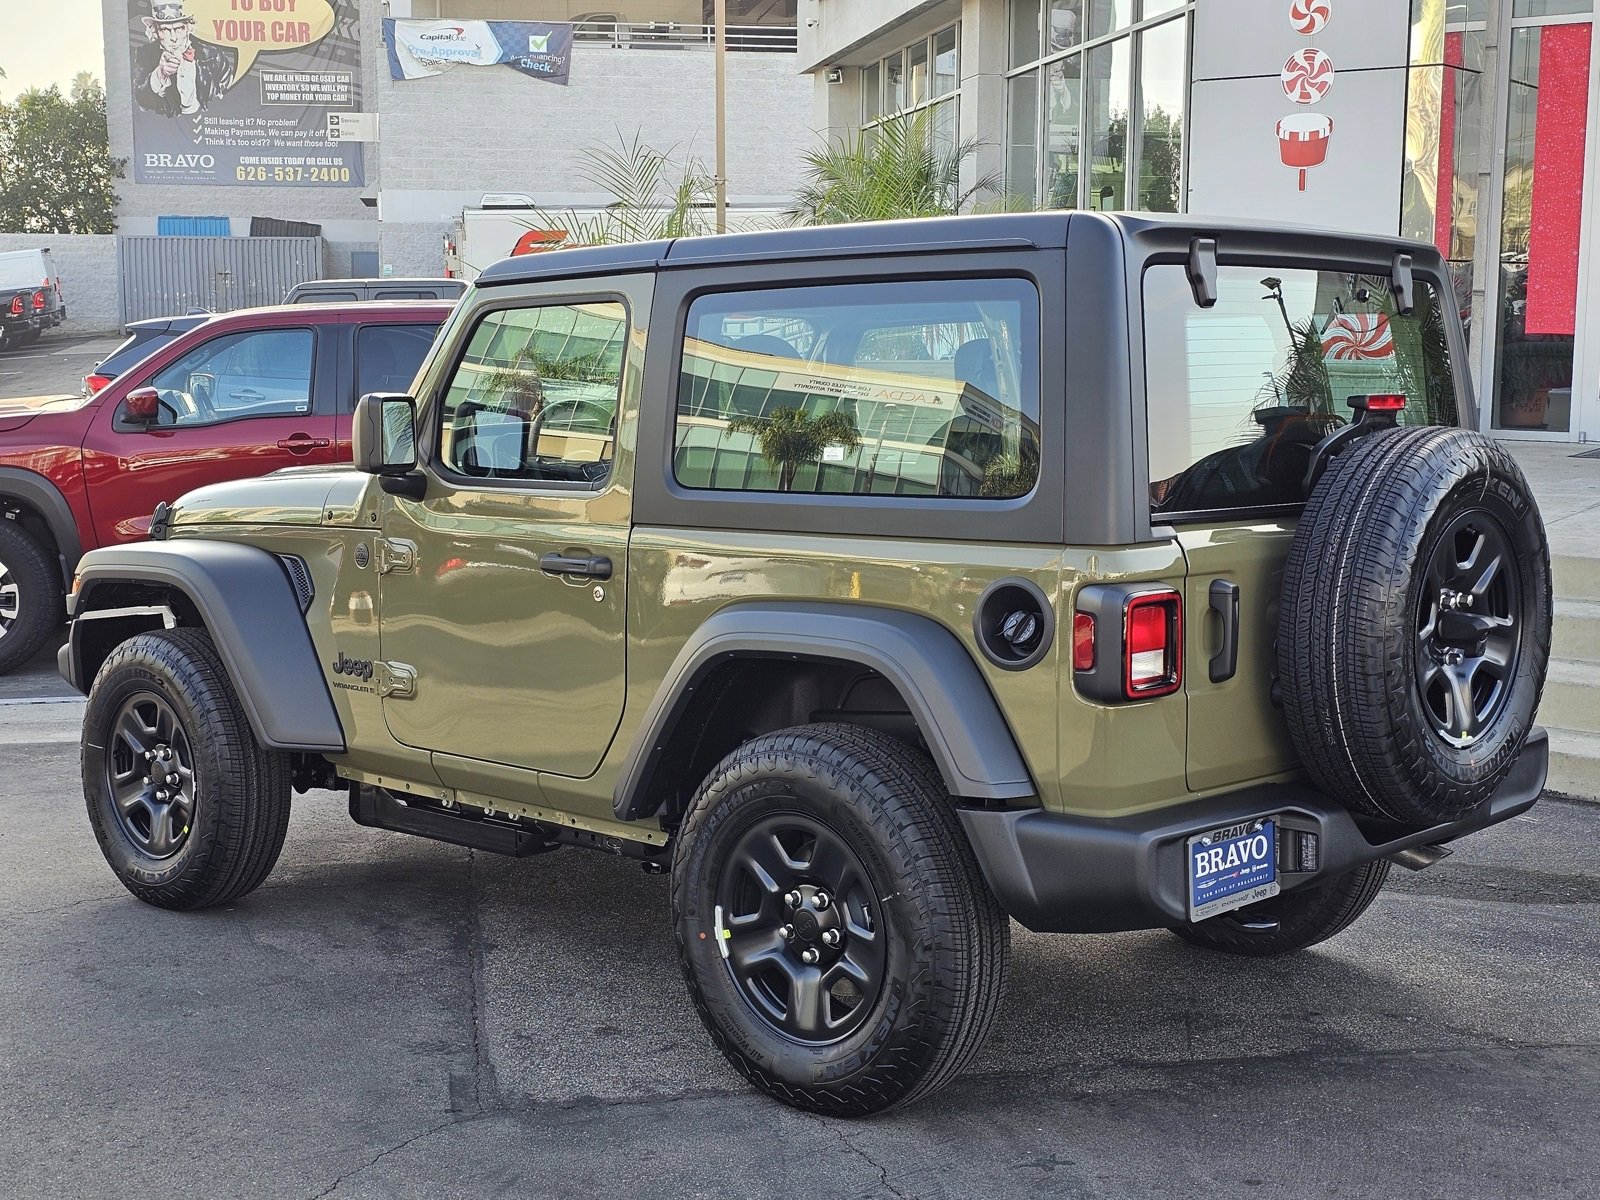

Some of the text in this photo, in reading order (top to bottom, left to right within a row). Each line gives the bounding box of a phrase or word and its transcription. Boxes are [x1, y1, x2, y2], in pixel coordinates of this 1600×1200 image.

[212, 19, 311, 43] YOUR CAR
[520, 58, 553, 73] Check.
[263, 73, 350, 83] WE ARE IN NEED OF USED CAR
[300, 84, 310, 92] SO
[310, 84, 320, 92] WE
[321, 84, 336, 92] WILL
[336, 85, 348, 93] PAY
[266, 92, 279, 100] TOP
[280, 93, 301, 101] MONEY
[302, 93, 314, 101] FOR
[314, 93, 332, 101] YOUR
[204, 116, 298, 127] Still leasing it? No problem!
[204, 127, 229, 137] Making
[294, 130, 308, 138] pay
[315, 129, 325, 137] off
[204, 138, 224, 146] Think
[225, 138, 236, 146] it's
[237, 138, 249, 146] too
[250, 138, 271, 146] old??
[274, 139, 285, 147] We
[304, 139, 324, 147] those
[324, 139, 339, 148] too!
[144, 153, 215, 168] BRAVO
[240, 156, 343, 166] COME INSIDE TODAY OR CALL US
[236, 166, 350, 182] 626-537-2400
[333, 651, 374, 683] Jeep
[332, 680, 369, 693] WRANGLER
[1212, 820, 1257, 843] BRAVO
[1194, 834, 1269, 879] BRAVO
[1251, 888, 1268, 899] Jeep
[825, 993, 901, 1080] NEXEN
